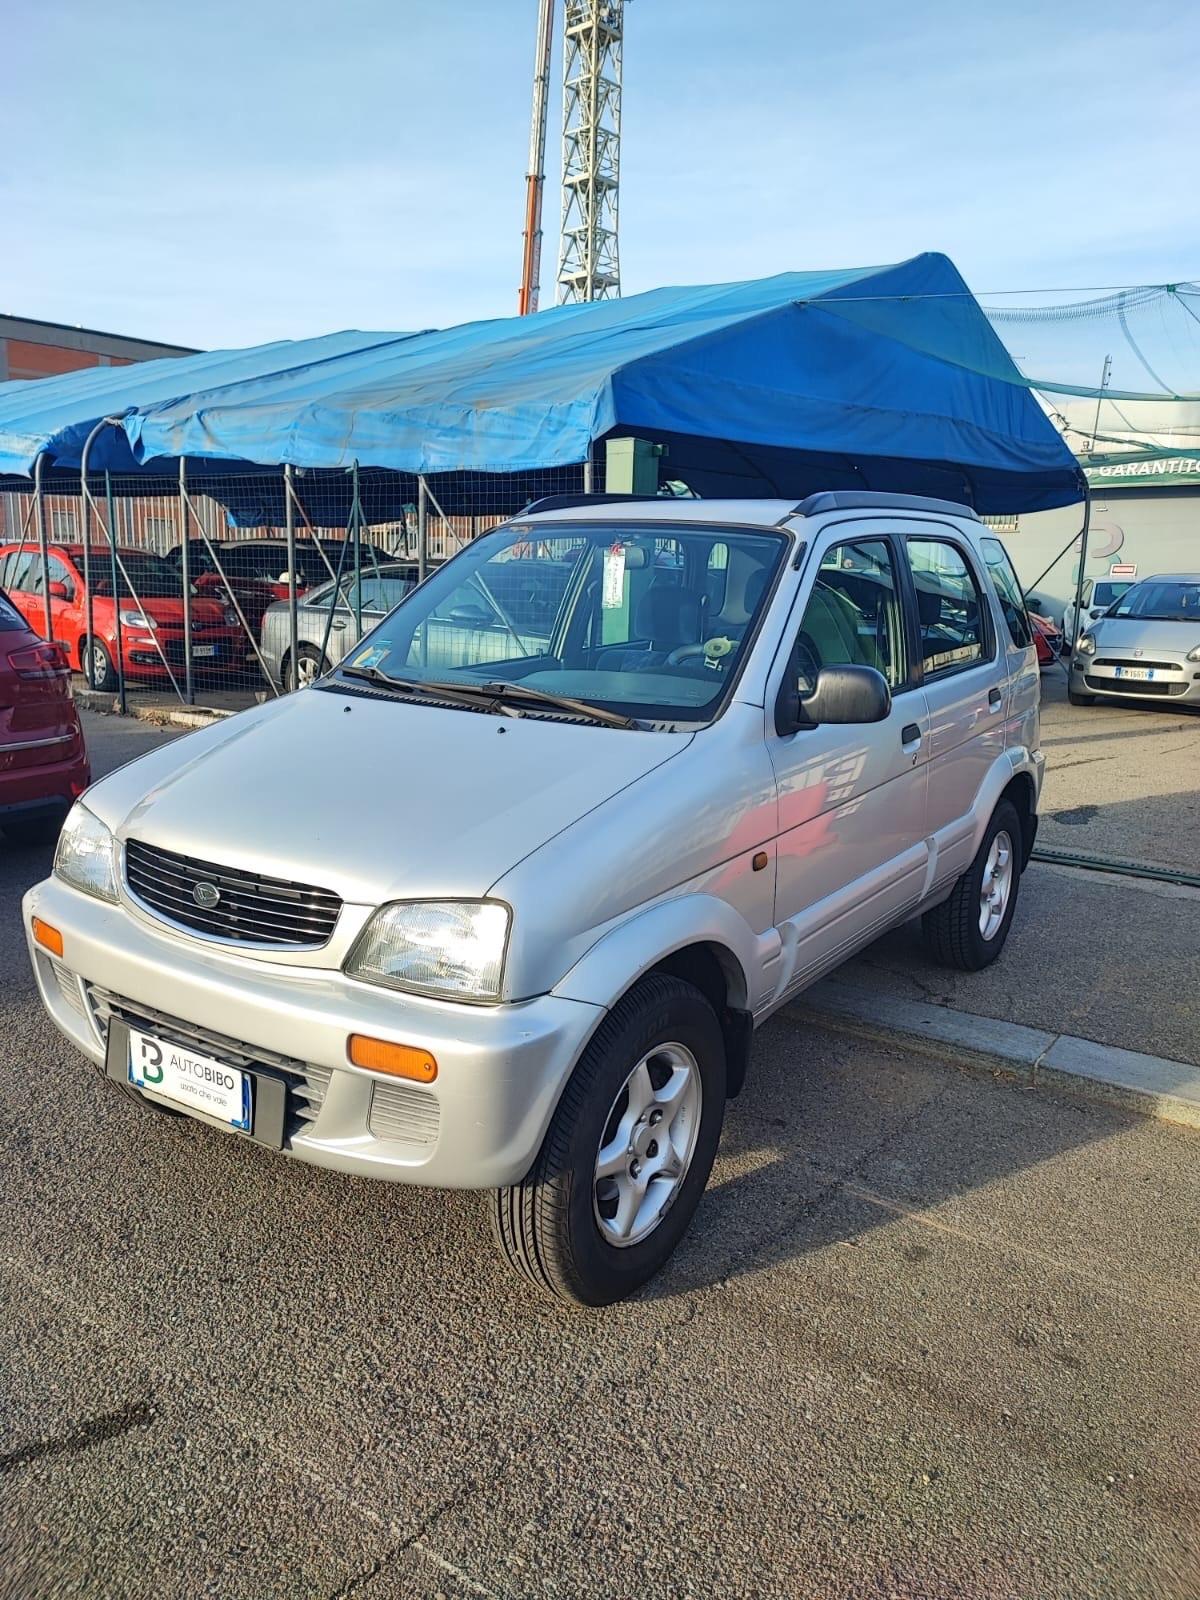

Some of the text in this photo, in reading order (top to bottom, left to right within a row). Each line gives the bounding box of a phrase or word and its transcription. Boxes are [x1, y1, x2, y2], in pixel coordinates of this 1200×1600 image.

[170, 1054, 235, 1090] AUTOBIBO
[180, 1082, 198, 1095] usato
[198, 1087, 212, 1101] che
